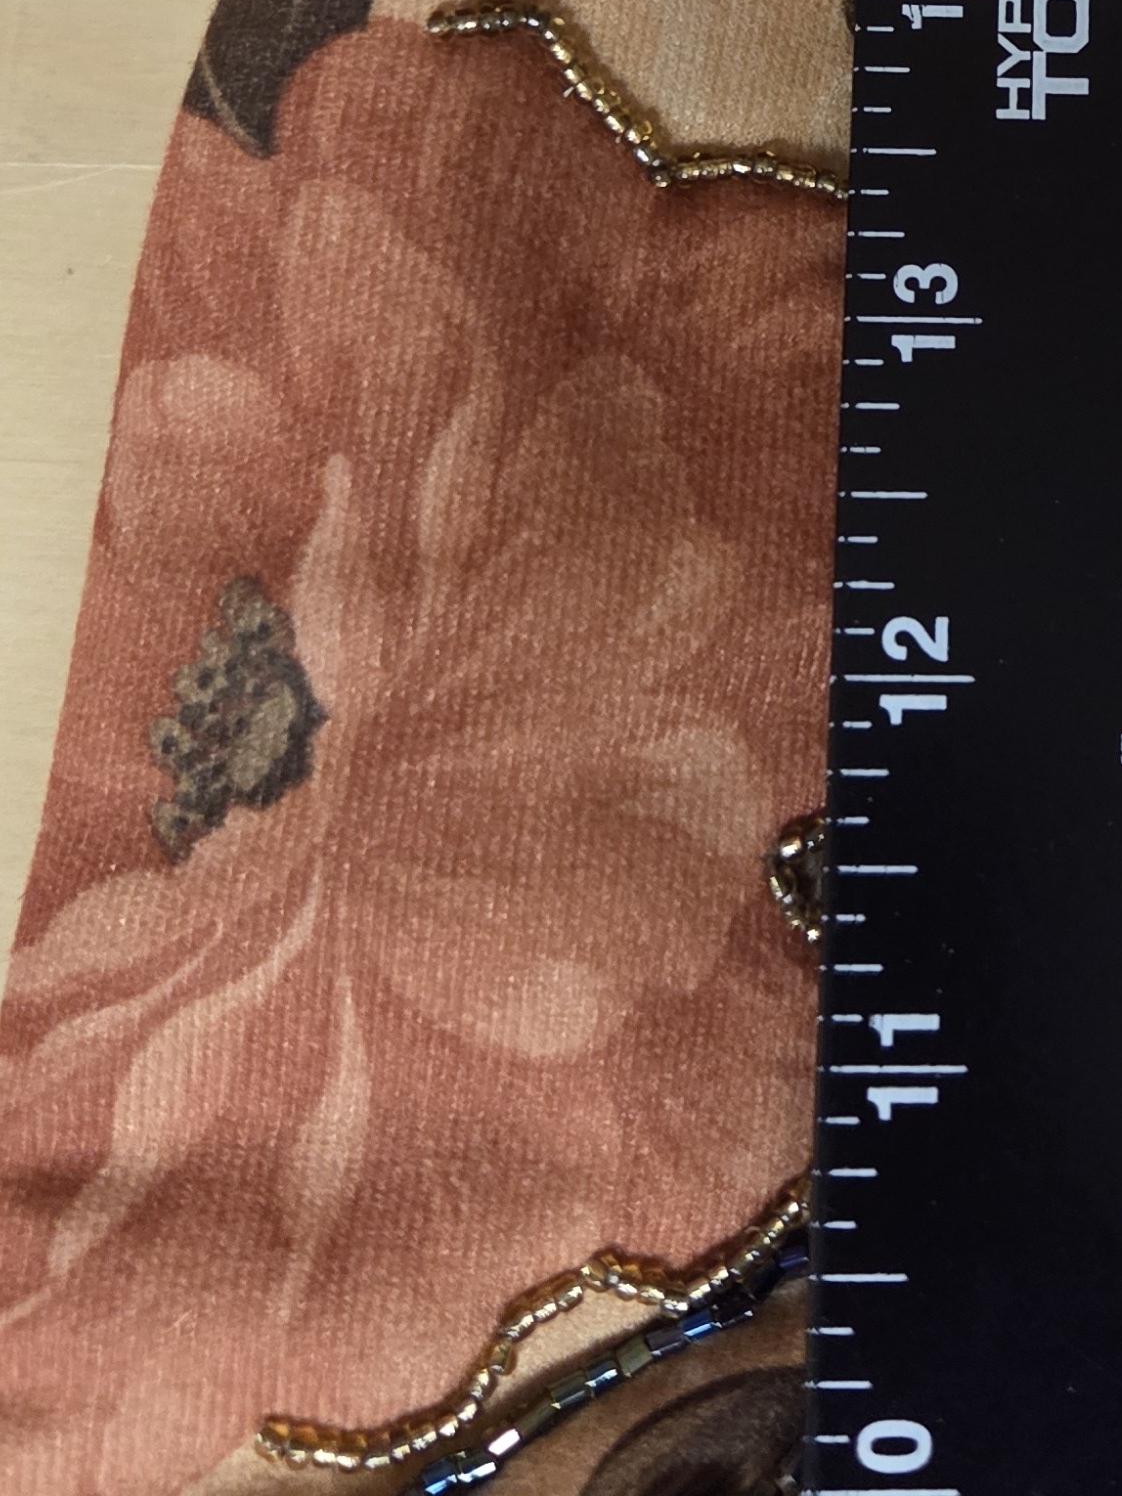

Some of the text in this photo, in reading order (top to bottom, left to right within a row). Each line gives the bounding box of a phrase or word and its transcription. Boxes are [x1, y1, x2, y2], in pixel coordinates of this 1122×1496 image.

[891, 264, 958, 362] 13
[879, 617, 949, 724] 12
[867, 1014, 940, 1120] 11
